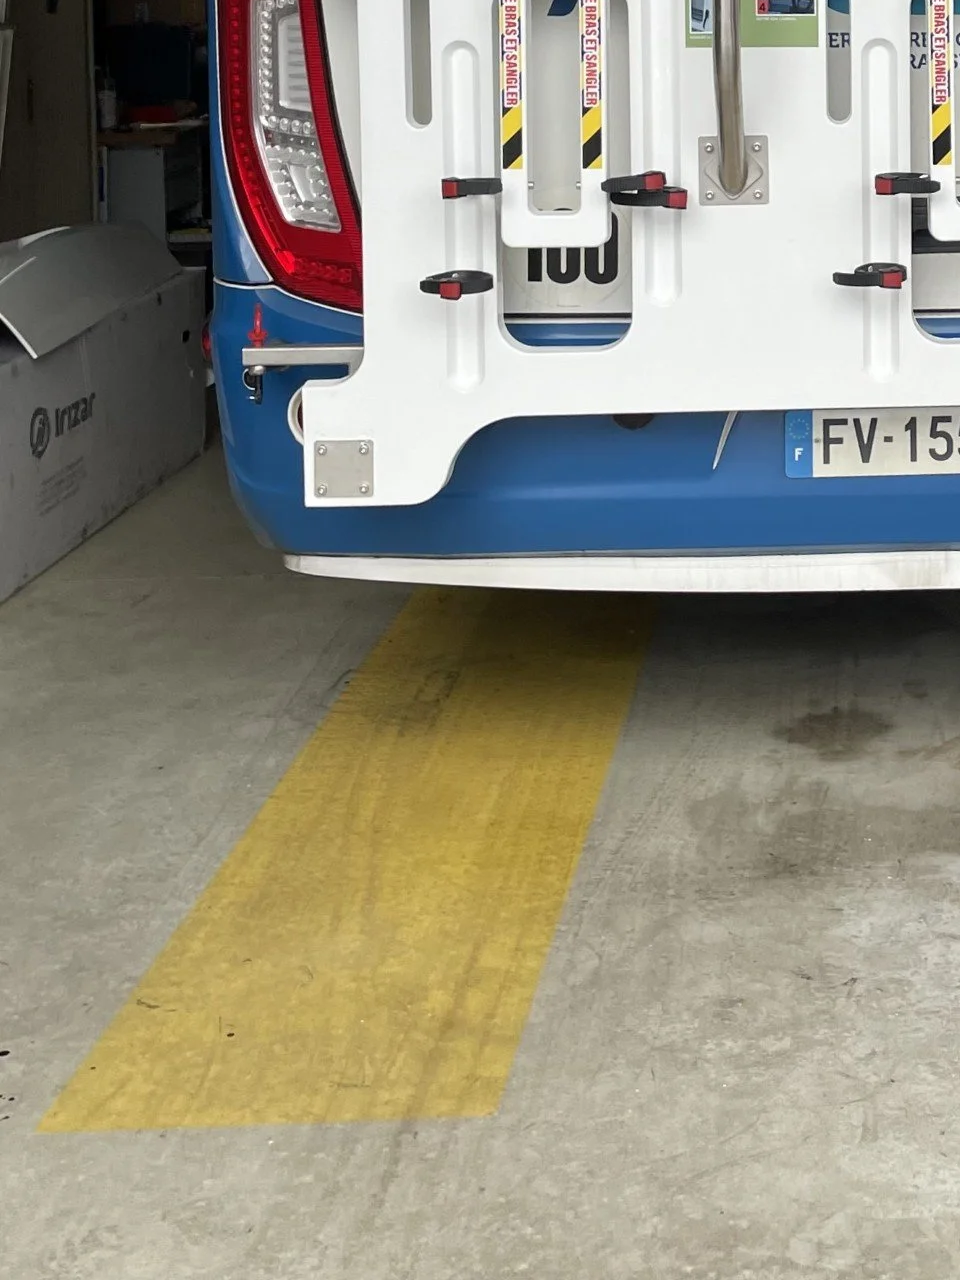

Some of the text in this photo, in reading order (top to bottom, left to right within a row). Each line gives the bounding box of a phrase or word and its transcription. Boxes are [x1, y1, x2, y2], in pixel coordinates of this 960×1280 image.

[505, 5, 517, 36] BRAS
[585, 6, 597, 36] BRAS
[759, 2, 766, 12] 4
[934, 5, 945, 35] BRAS
[505, 38, 518, 52] ET
[585, 39, 597, 52] ET
[935, 37, 946, 50] ET
[505, 54, 518, 106] SANGLER
[586, 55, 598, 106] SANGLER
[935, 53, 947, 103] SANGLER
[795, 448, 804, 461] F
